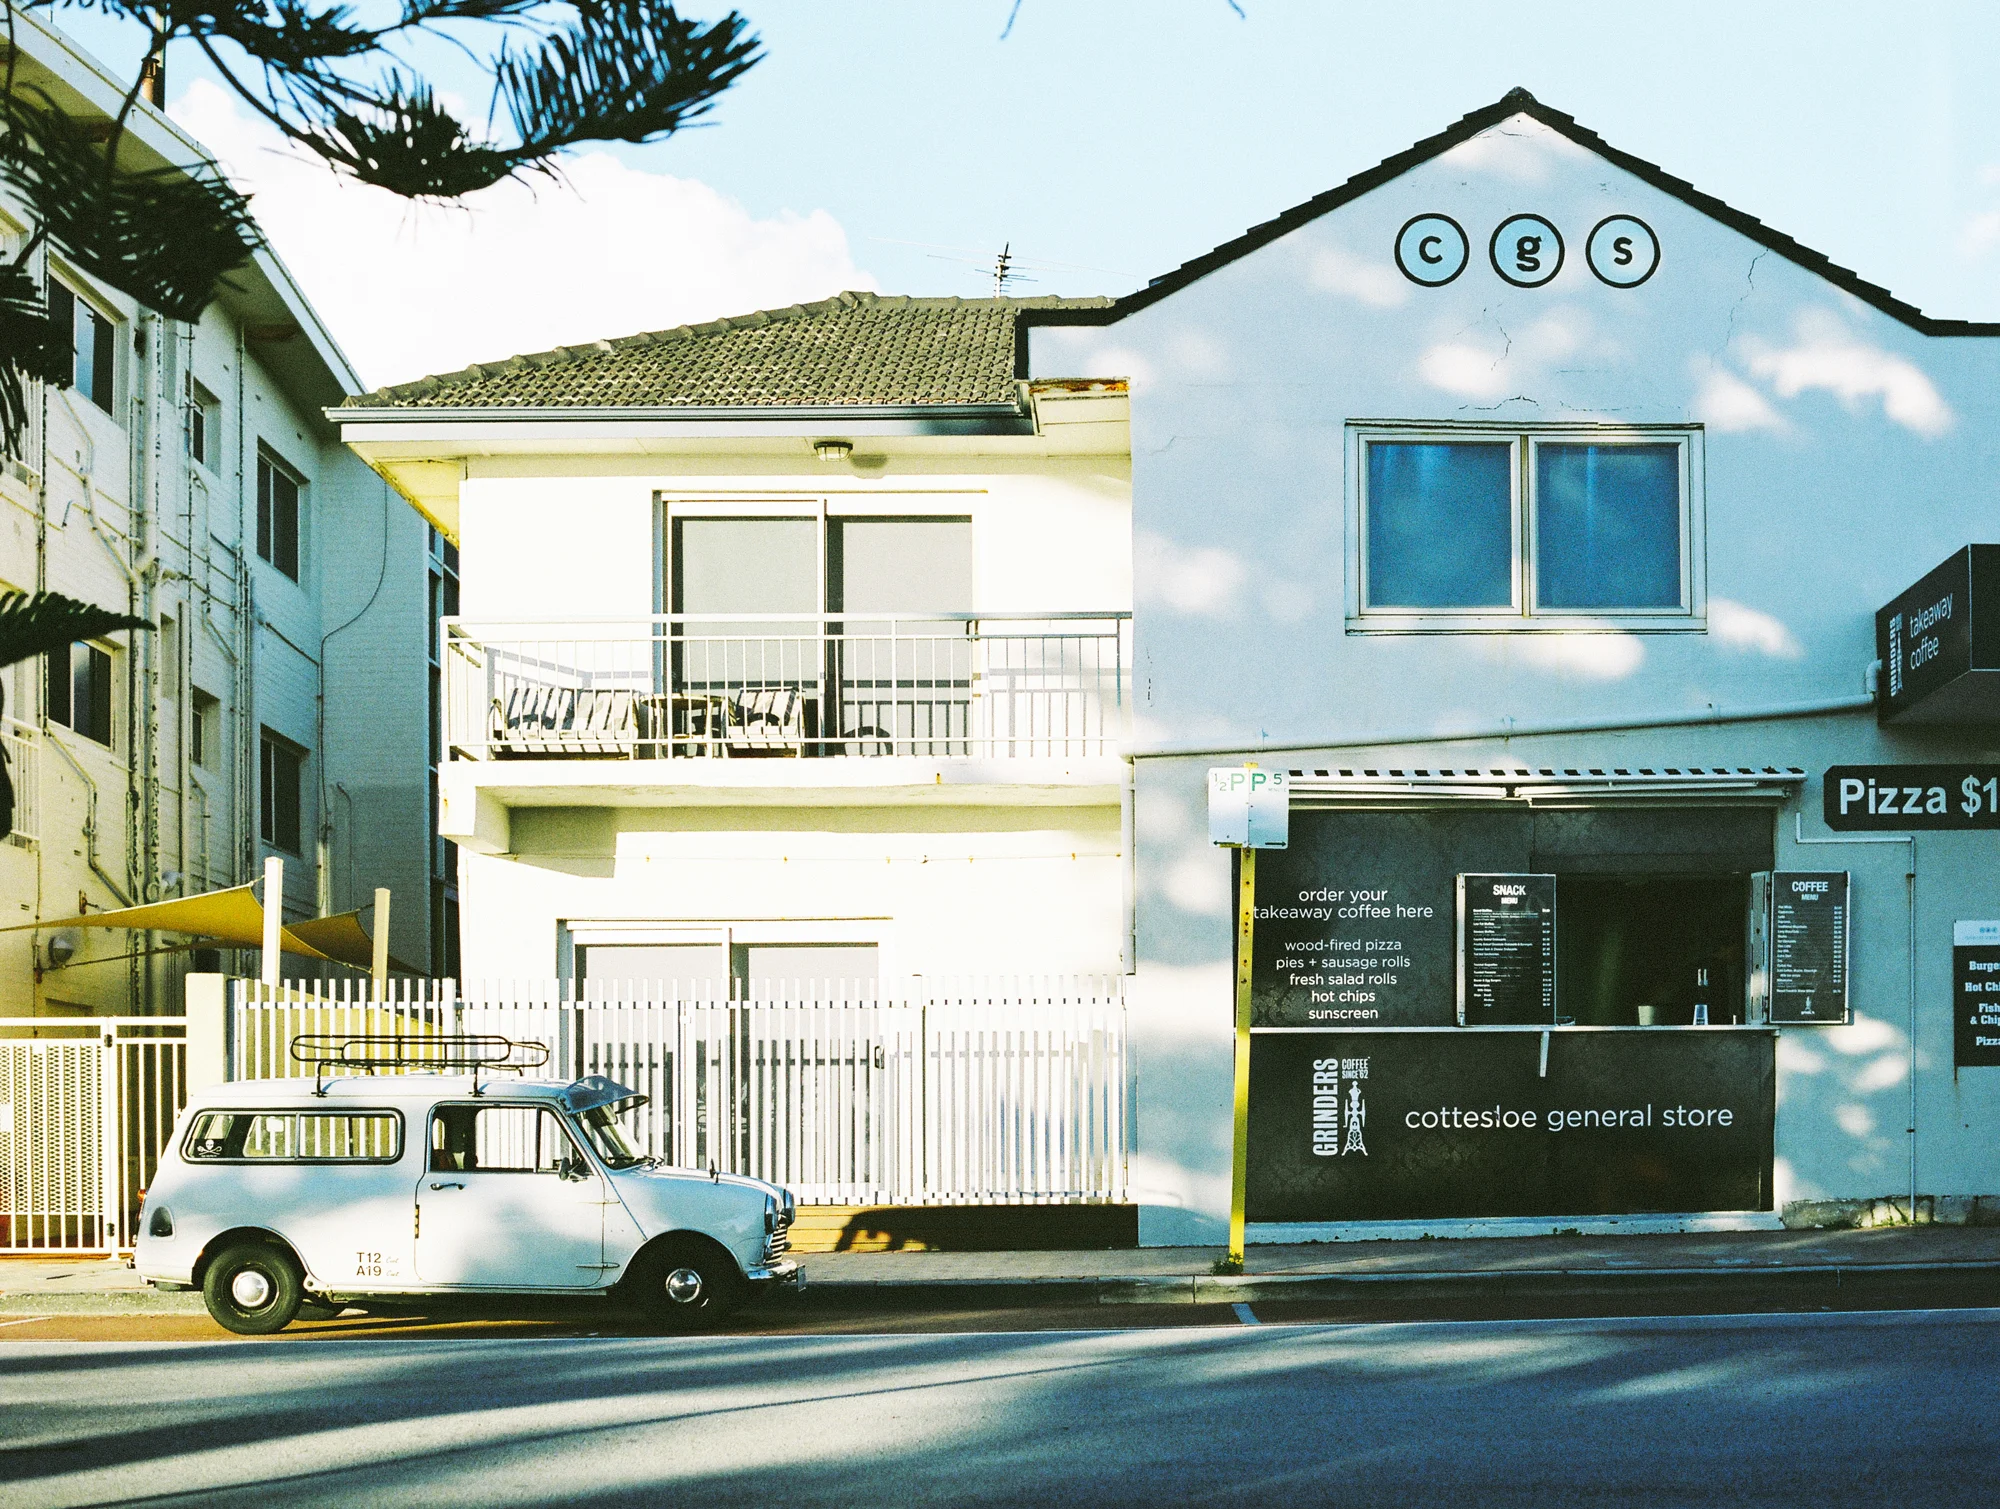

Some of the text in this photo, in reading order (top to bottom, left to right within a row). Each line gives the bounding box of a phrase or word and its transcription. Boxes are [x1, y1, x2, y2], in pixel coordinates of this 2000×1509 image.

[1516, 235, 1543, 272] g
[1909, 593, 1953, 638] takeaway
[1910, 635, 1939, 670] coffee
[1251, 773, 1283, 792] P 5
[1839, 774, 1998, 818] Pizza $1
[1492, 884, 1527, 896] SNACK
[1791, 881, 1829, 892] COFFEE
[1298, 887, 1389, 904] order your
[1500, 896, 1519, 904] MENU
[1801, 893, 1819, 901] MENU
[1253, 904, 1434, 921] takeaway coffee here
[1284, 938, 1402, 953] wood-fired pizza
[1276, 957, 1305, 971] pies
[1321, 957, 1378, 970] sausage
[1382, 955, 1411, 968] rolls
[1289, 972, 1398, 986] fresh salad rolls
[1964, 981, 1983, 992] Hot
[1311, 990, 1376, 1004] hot chips
[1308, 1009, 1379, 1020] sunscreen
[1978, 1002, 2000, 1013] Fish
[1969, 1015, 1978, 1025] &
[1341, 1058, 1369, 1070] COFFEE
[1312, 1058, 1339, 1156] GRINDERS
[1405, 1103, 1733, 1132] cottesloe general store
[356, 1252, 381, 1263] T12
[356, 1265, 382, 1277] A19
